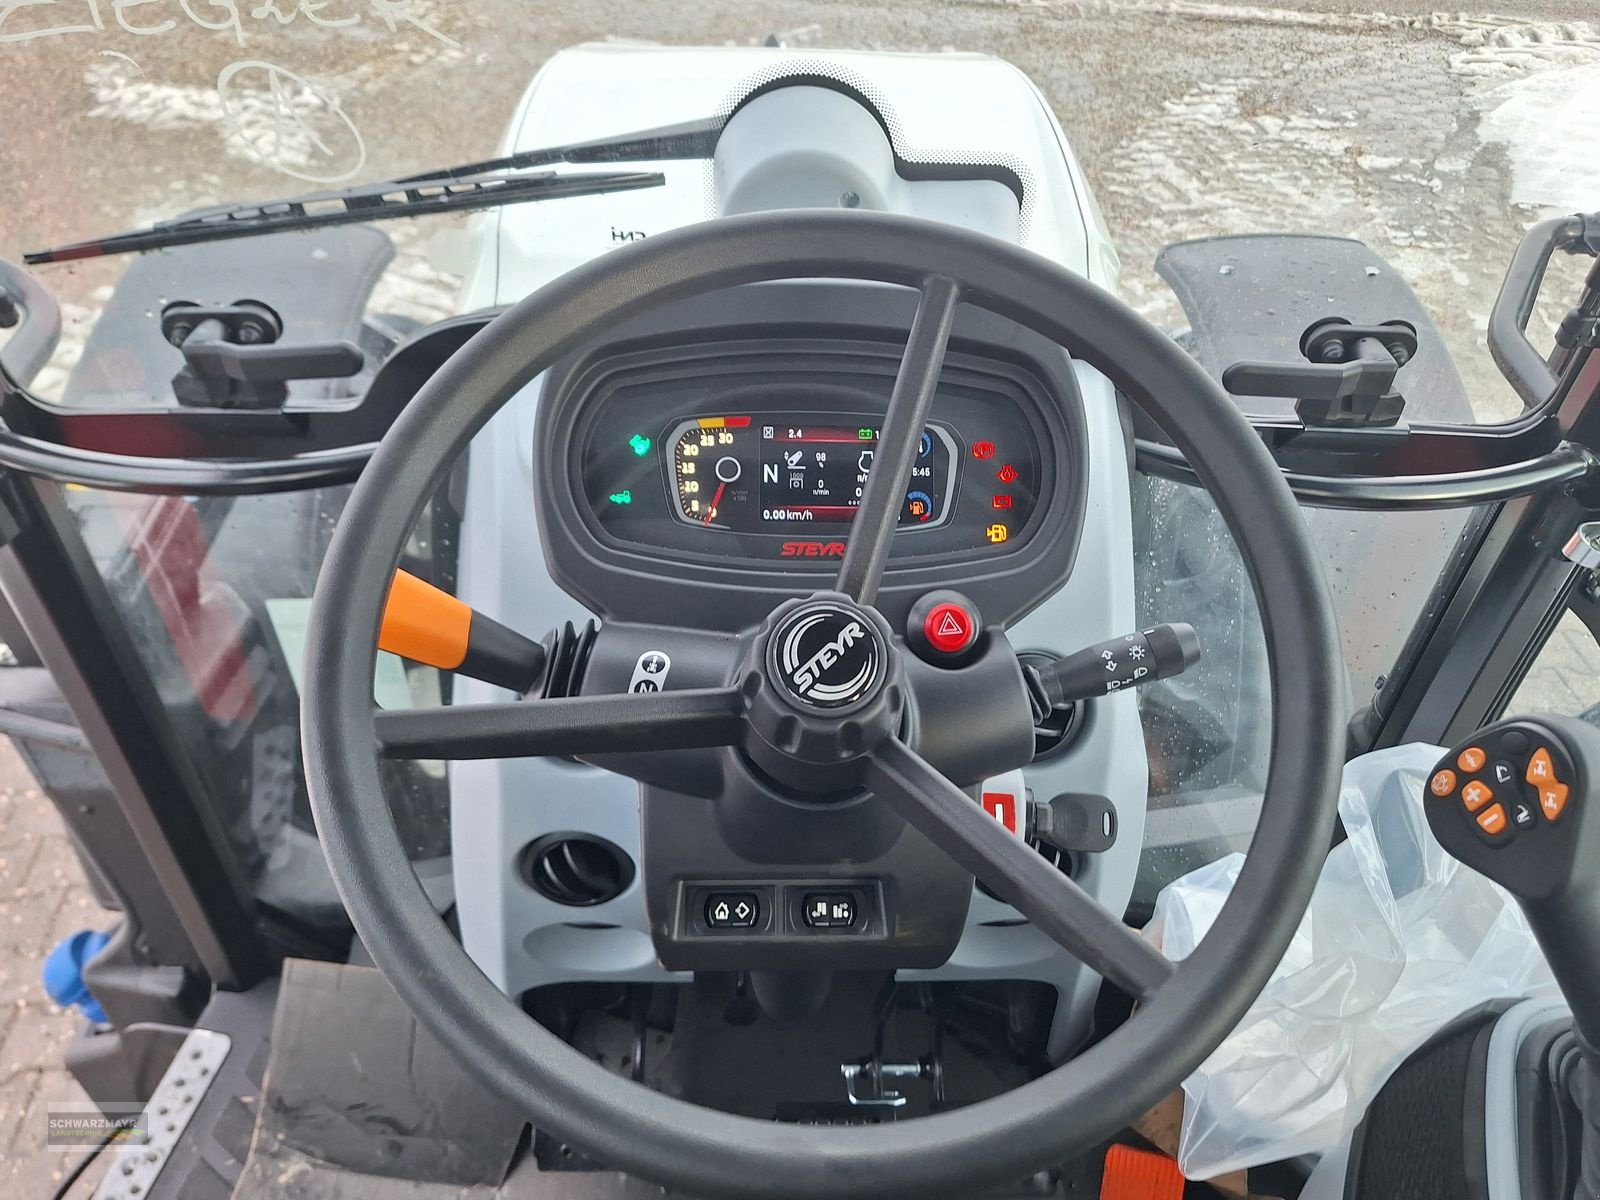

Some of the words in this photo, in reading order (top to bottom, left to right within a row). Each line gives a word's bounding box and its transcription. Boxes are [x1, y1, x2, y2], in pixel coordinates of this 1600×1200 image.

[719, 432, 734, 444] 30
[788, 428, 803, 439] 2.4
[700, 434, 715, 447] 25
[683, 444, 699, 456] 20
[815, 452, 827, 462] 98
[681, 462, 696, 474] 15
[763, 463, 779, 484] N
[684, 480, 699, 493] 10
[818, 479, 824, 489] 0
[812, 488, 830, 496] n/min
[690, 499, 700, 512] 5
[763, 508, 786, 520] 0.00
[786, 508, 813, 521] km/h
[781, 541, 846, 557] STEYR
[793, 621, 865, 694] STEYR
